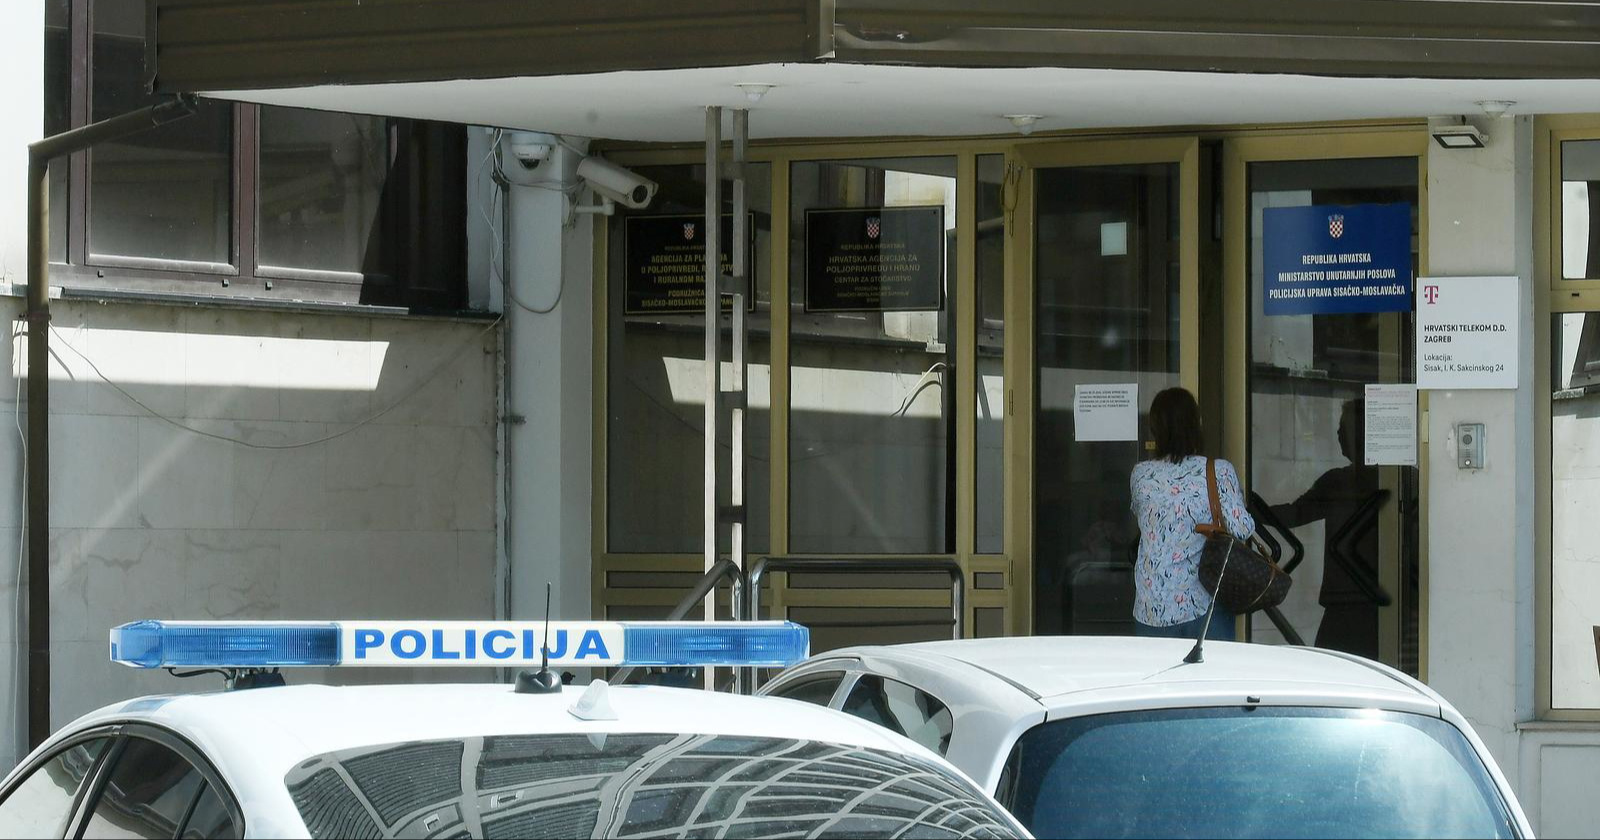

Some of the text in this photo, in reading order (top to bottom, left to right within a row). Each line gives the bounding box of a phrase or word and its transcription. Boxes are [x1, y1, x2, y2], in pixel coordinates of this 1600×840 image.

[651, 254, 683, 263] AGENCIJA
[685, 254, 692, 262] ZA
[1302, 253, 1371, 265] REPUBLIKA HRVATSKA
[826, 265, 888, 273] POLJOPRIVREDU
[870, 275, 912, 283] STOČARSTVO
[1279, 269, 1396, 282] MINISTARSTVO UNUTARNJIH POSLOVA
[1270, 284, 1405, 299] POLICIJSKA UPRAVA SISAČKO-MOSLAVAČKA
[1424, 286, 1438, 304] T
[1424, 354, 1452, 362] Lokacija:
[1424, 364, 1443, 372] Sisak,
[1457, 364, 1494, 372] Sakcinskog
[354, 629, 610, 659] POLICIJA
